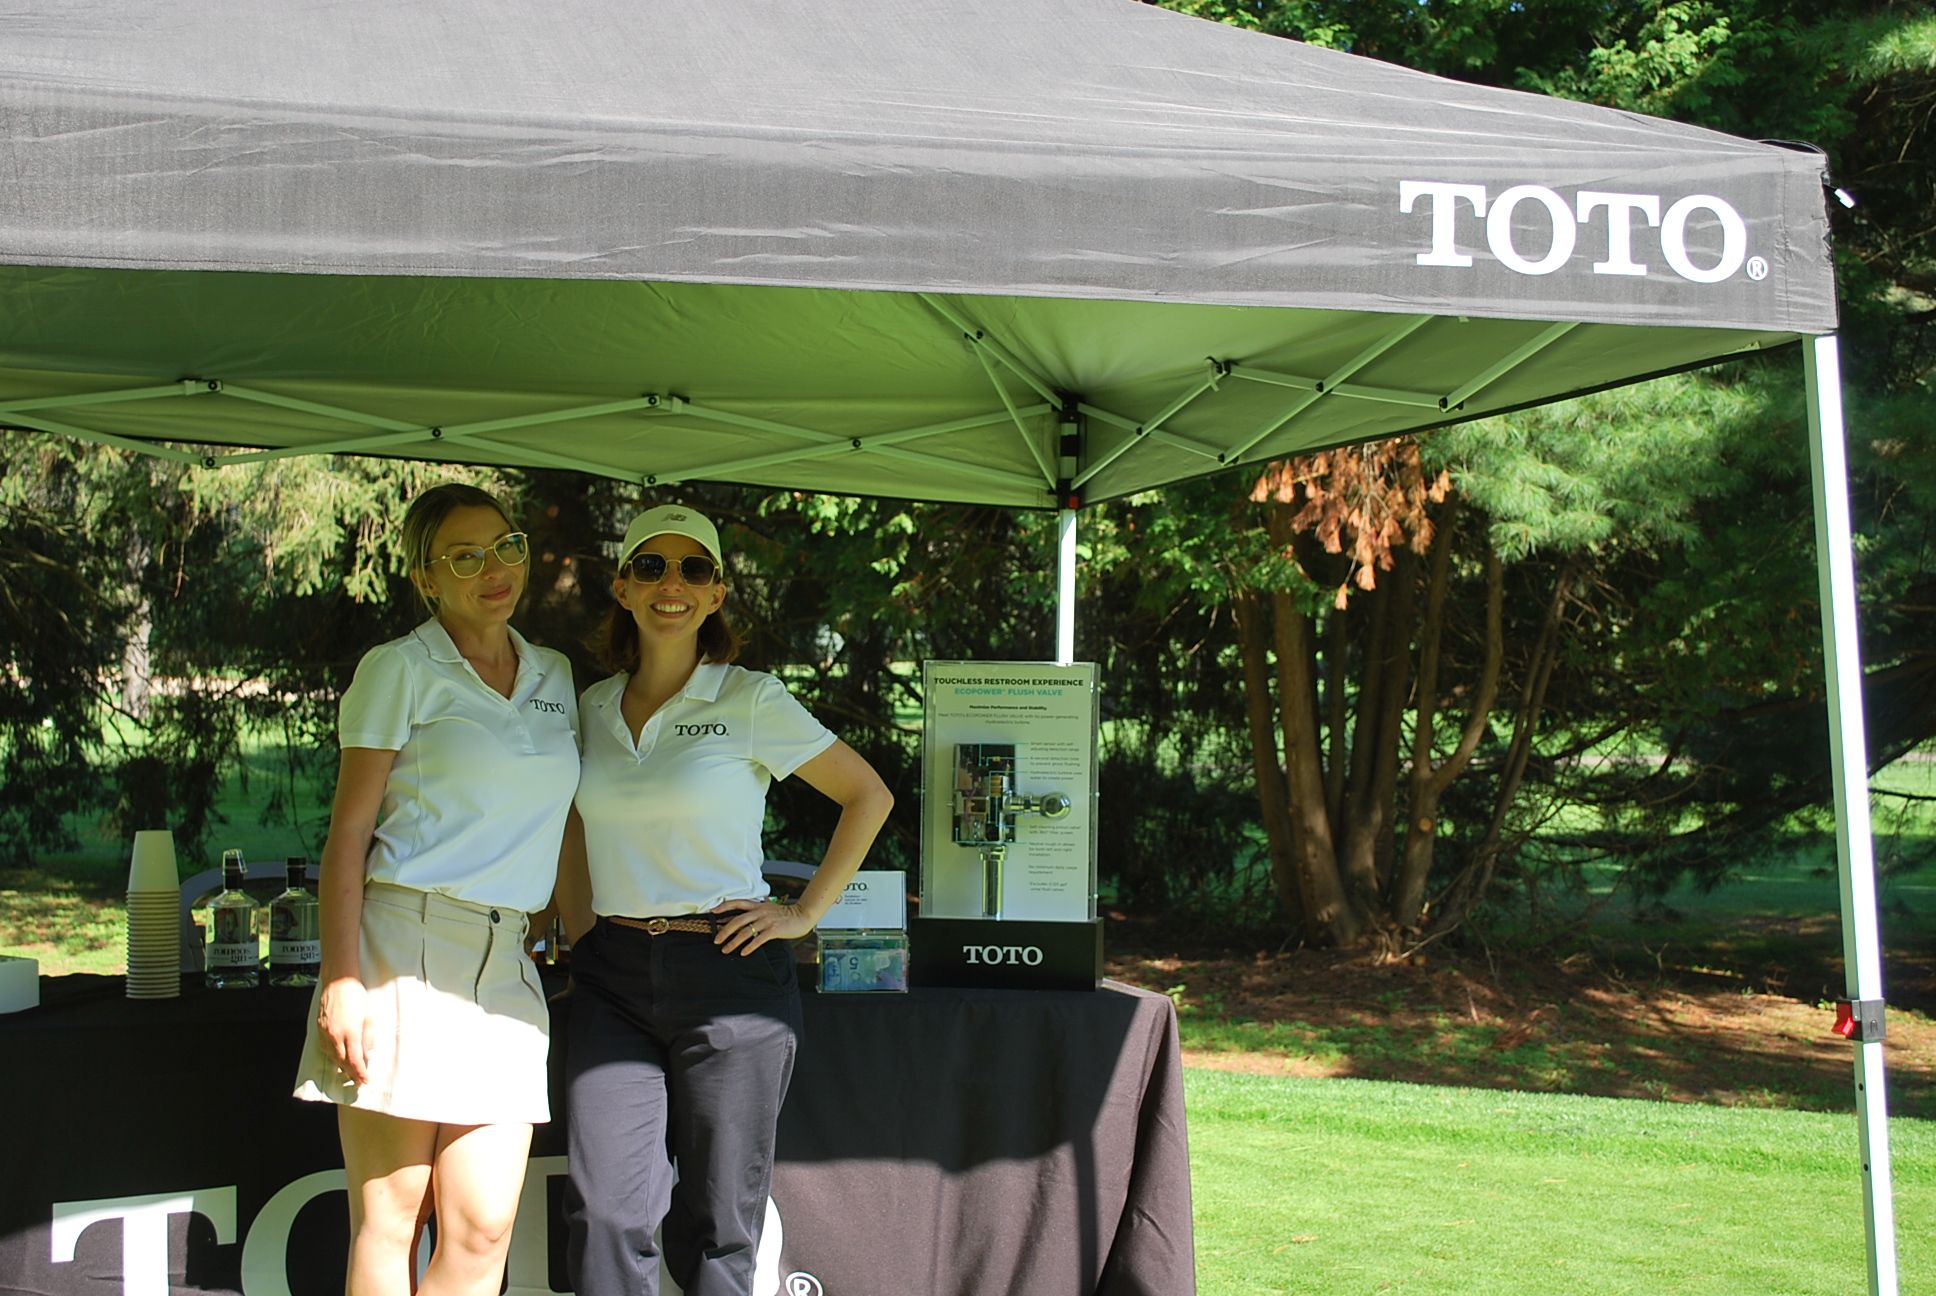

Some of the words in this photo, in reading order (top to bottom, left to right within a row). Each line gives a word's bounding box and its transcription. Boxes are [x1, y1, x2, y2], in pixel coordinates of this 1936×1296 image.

[934, 677, 982, 685] TOUCHLESS
[984, 678, 1030, 686] RESTROOM
[963, 945, 1043, 966] TOTO
